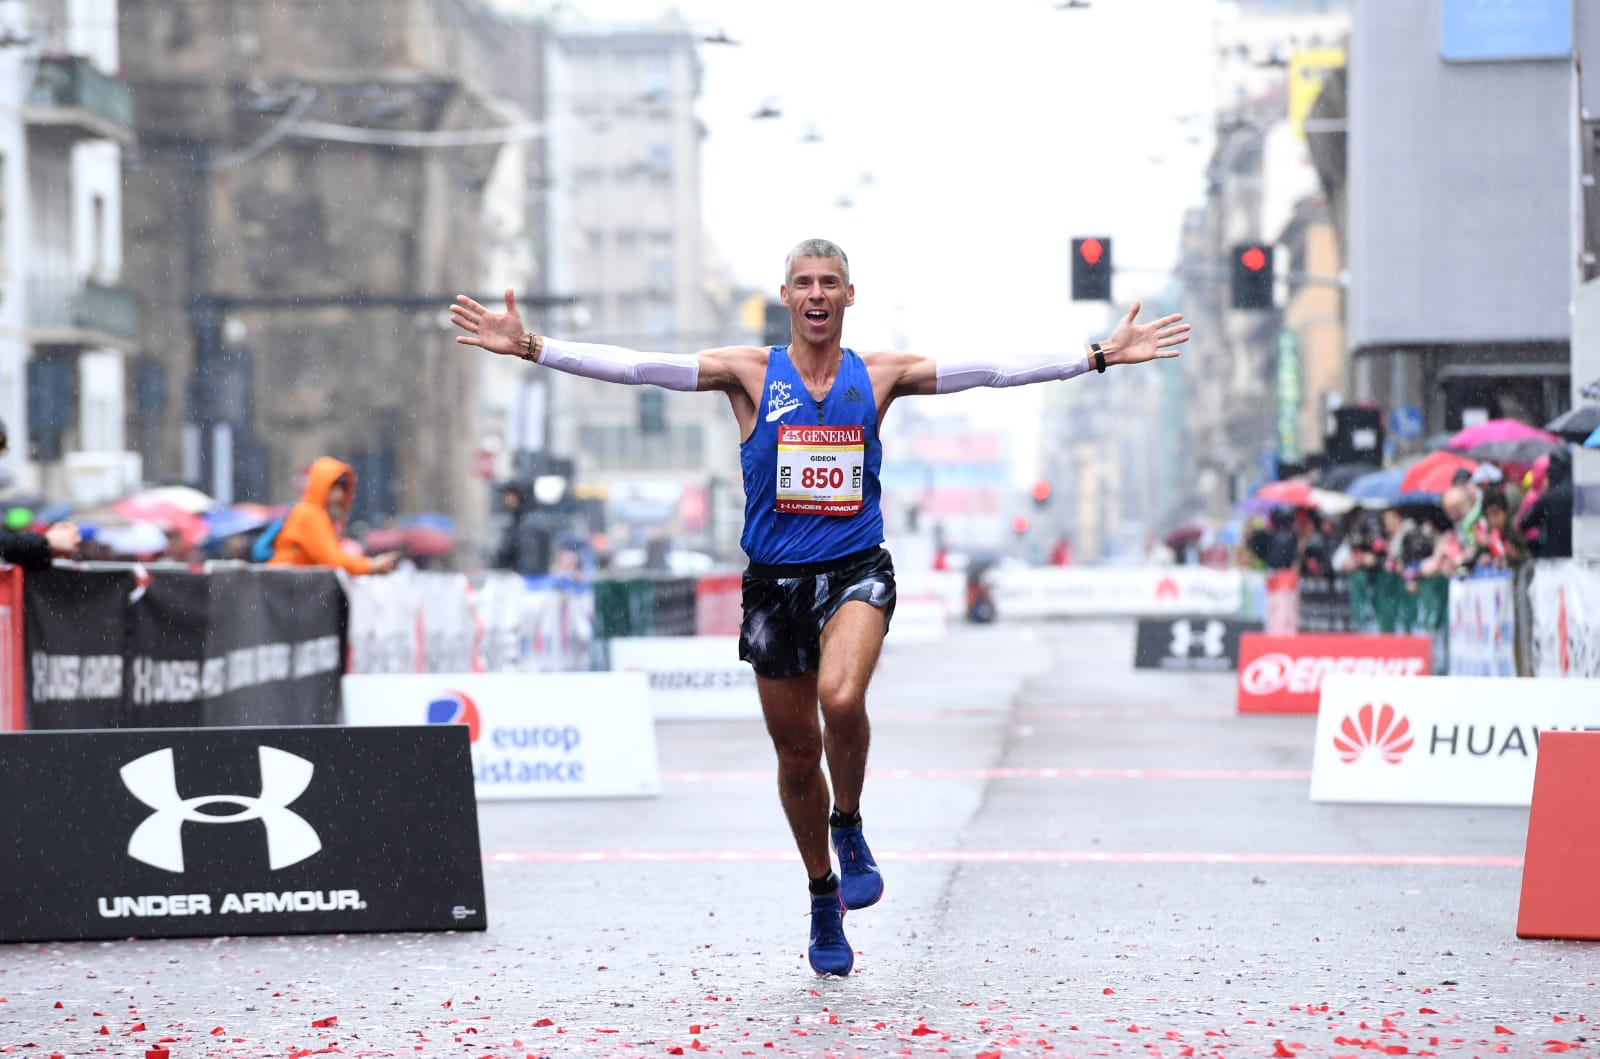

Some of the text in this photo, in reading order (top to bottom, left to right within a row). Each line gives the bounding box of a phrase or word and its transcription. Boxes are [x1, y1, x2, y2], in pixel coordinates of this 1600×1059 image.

[802, 430, 861, 443] GENERALI
[801, 467, 844, 489] 850
[792, 503, 860, 513] UNDER ARMOUR
[492, 726, 581, 753] europ
[1429, 725, 1600, 757] HUA
[475, 756, 585, 783] istance
[98, 889, 361, 918] UNDER ARMOUR
